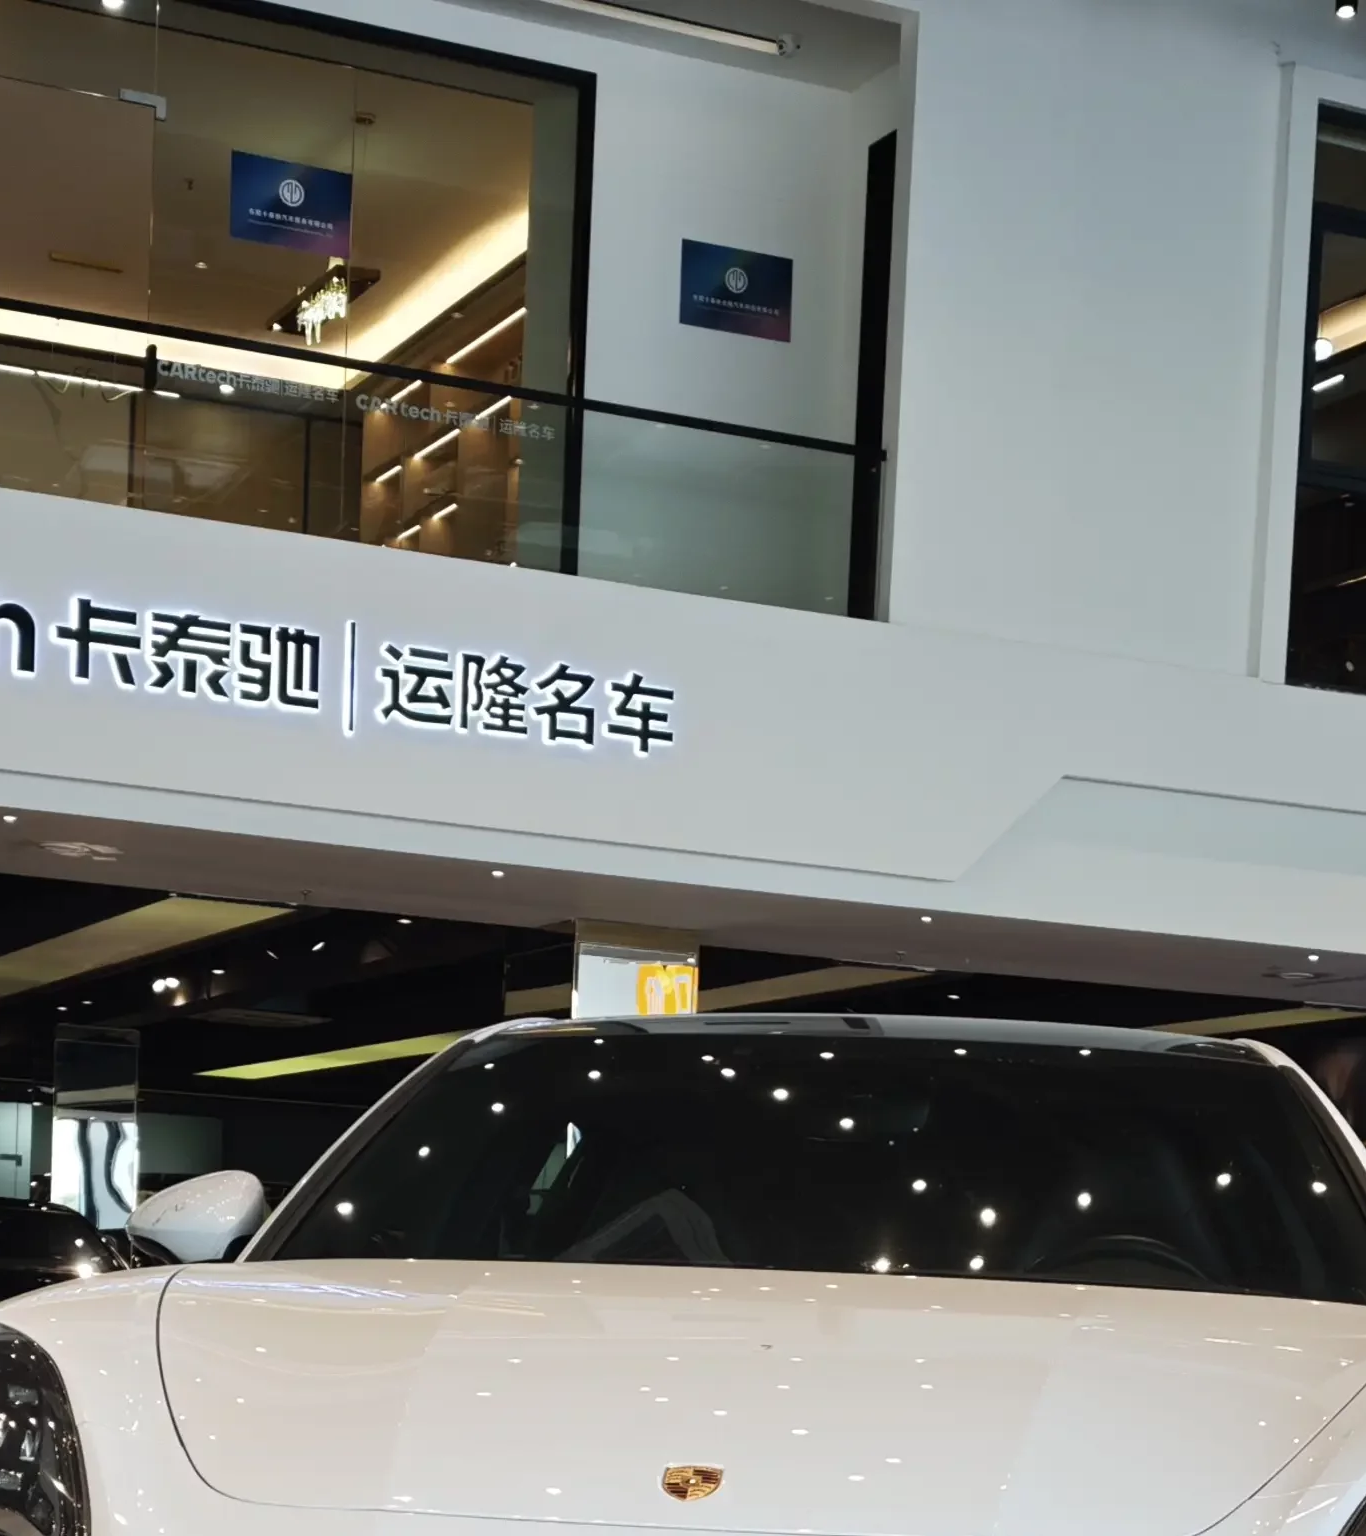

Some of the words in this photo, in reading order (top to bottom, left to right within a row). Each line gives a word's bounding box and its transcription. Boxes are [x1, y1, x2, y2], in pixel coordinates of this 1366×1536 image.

[157, 360, 236, 386] CARtech
[55, 596, 322, 705] 卡泰驰
[379, 643, 676, 753] 运隆名车
